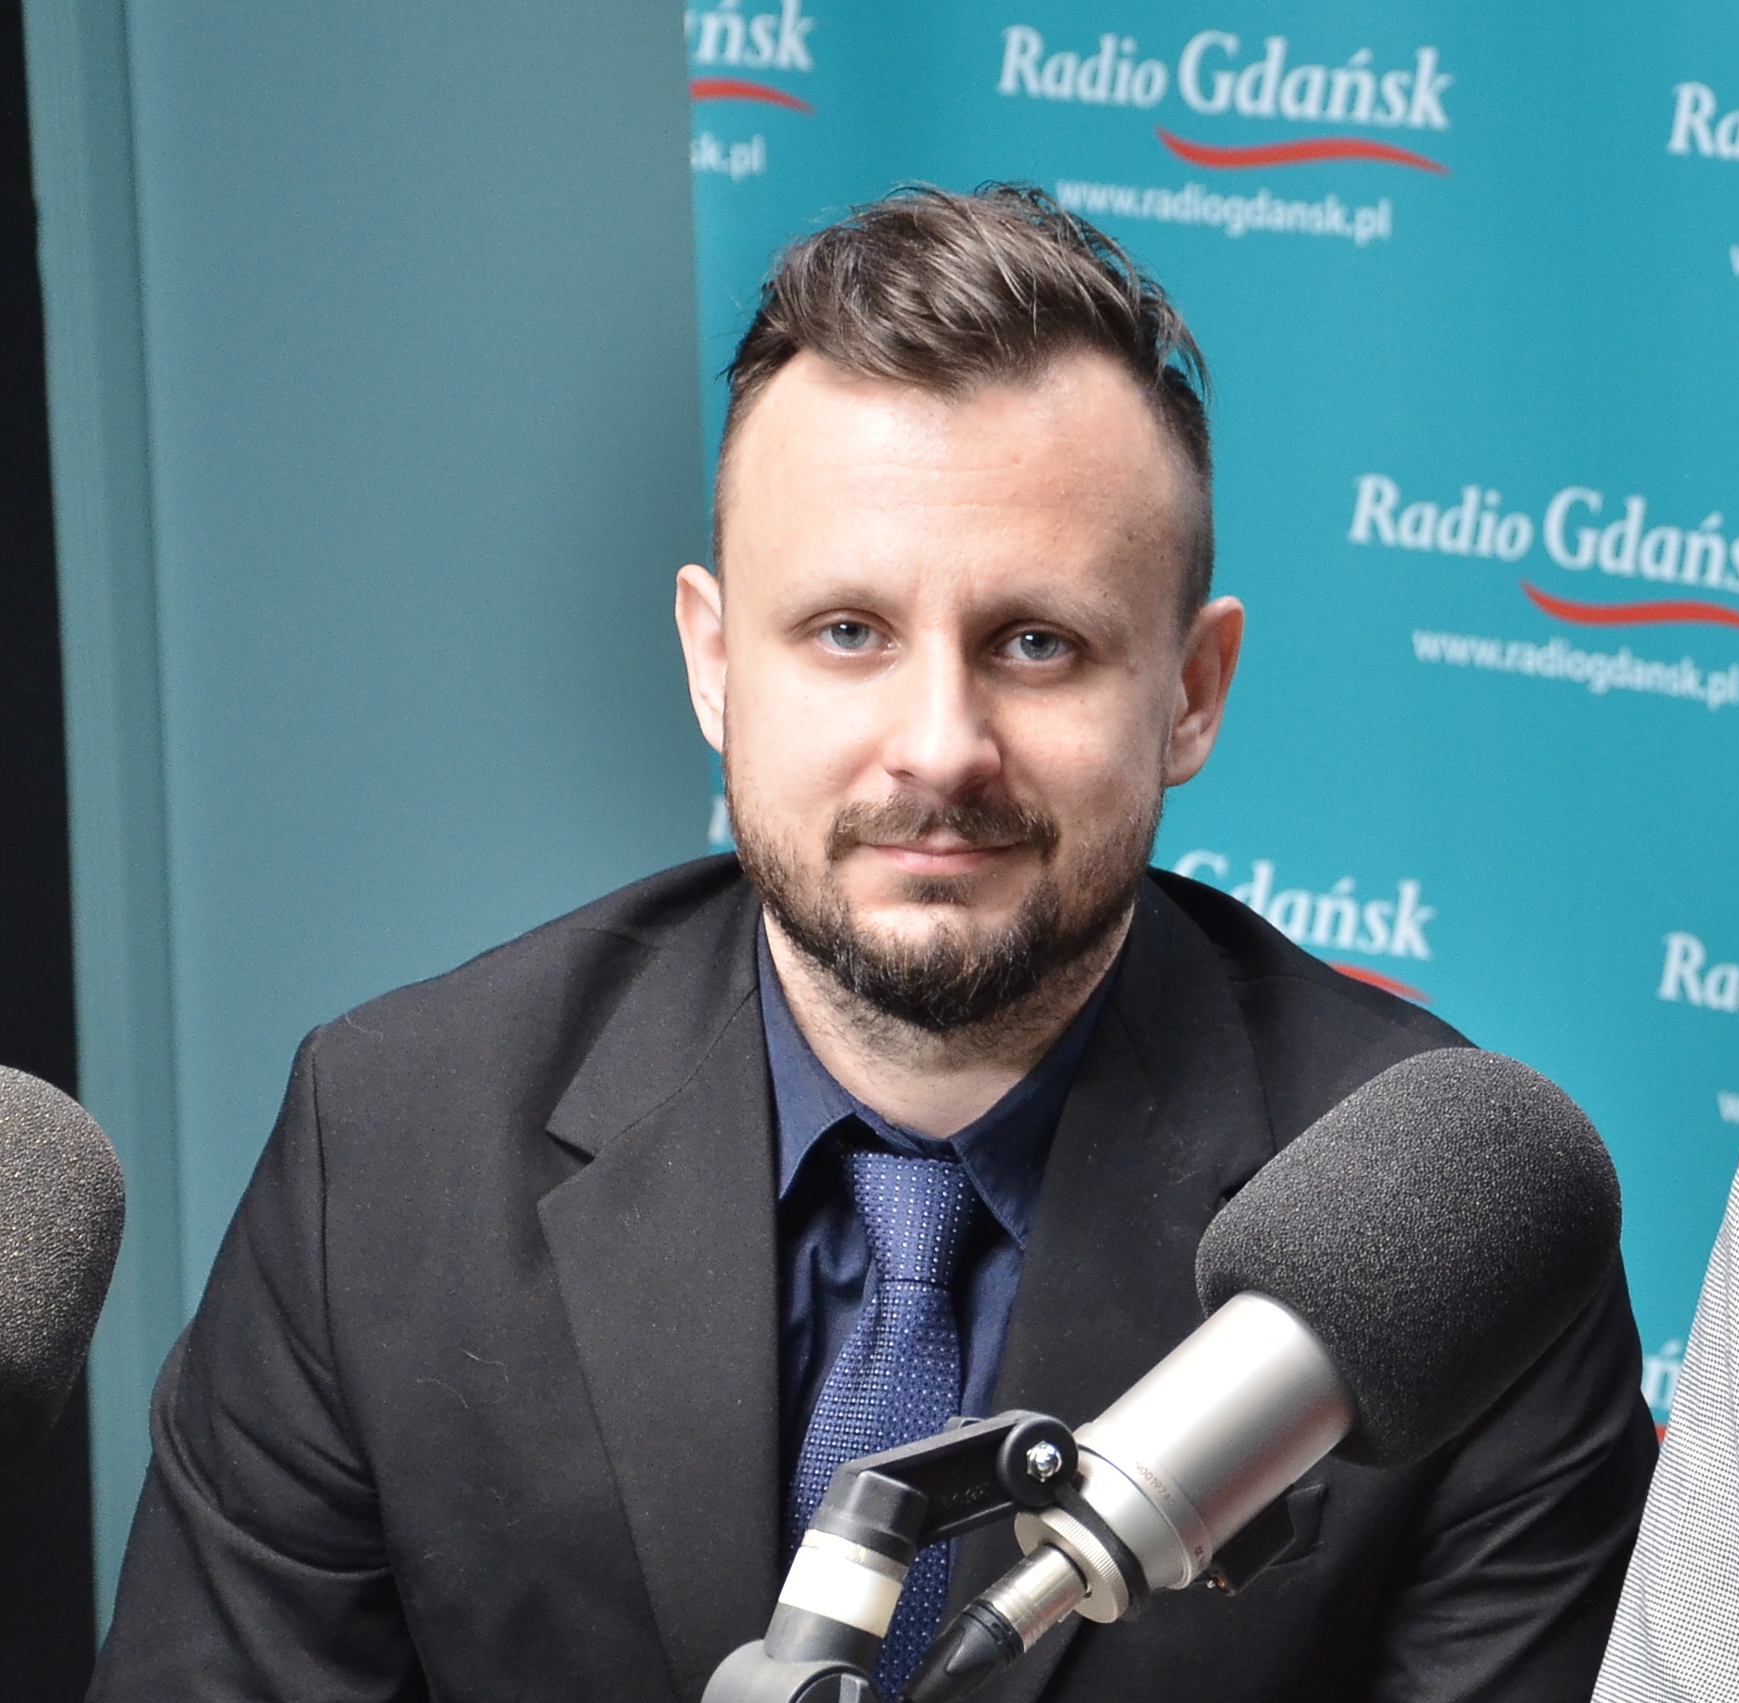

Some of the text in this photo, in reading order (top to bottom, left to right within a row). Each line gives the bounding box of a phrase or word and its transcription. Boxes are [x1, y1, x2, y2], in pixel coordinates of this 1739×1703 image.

[996, 24, 1453, 130] Radio Gdańsk
[1056, 180, 1392, 247] www.radiogdansk.pl
[1348, 473, 1534, 560] Radio
